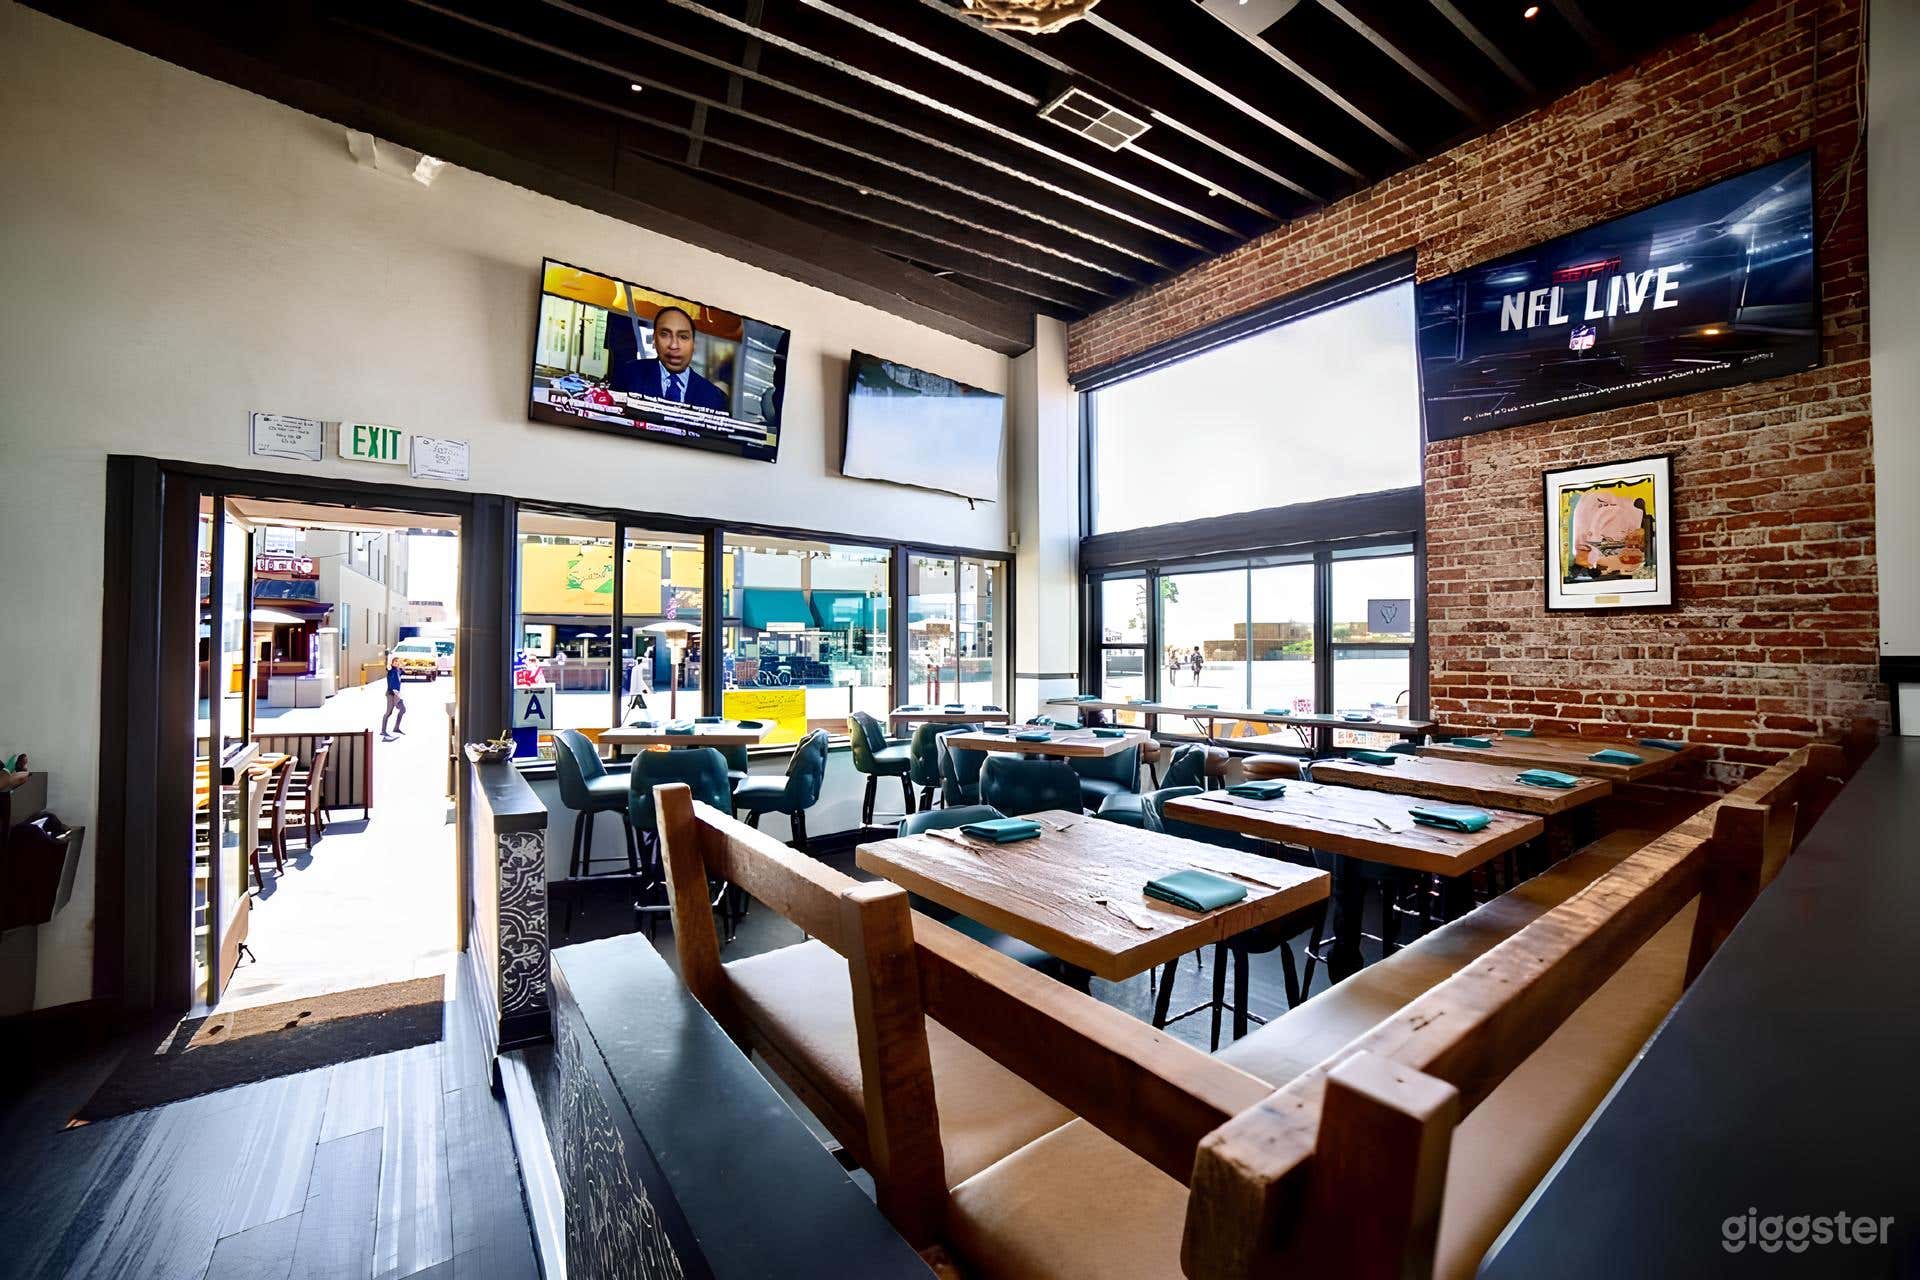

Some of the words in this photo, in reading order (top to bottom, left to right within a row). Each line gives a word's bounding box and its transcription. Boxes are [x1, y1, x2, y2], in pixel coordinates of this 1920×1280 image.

[1501, 286, 1568, 332] NFL
[1584, 264, 1684, 320] LIVE
[353, 425, 402, 460] EXIT
[524, 693, 546, 720] A
